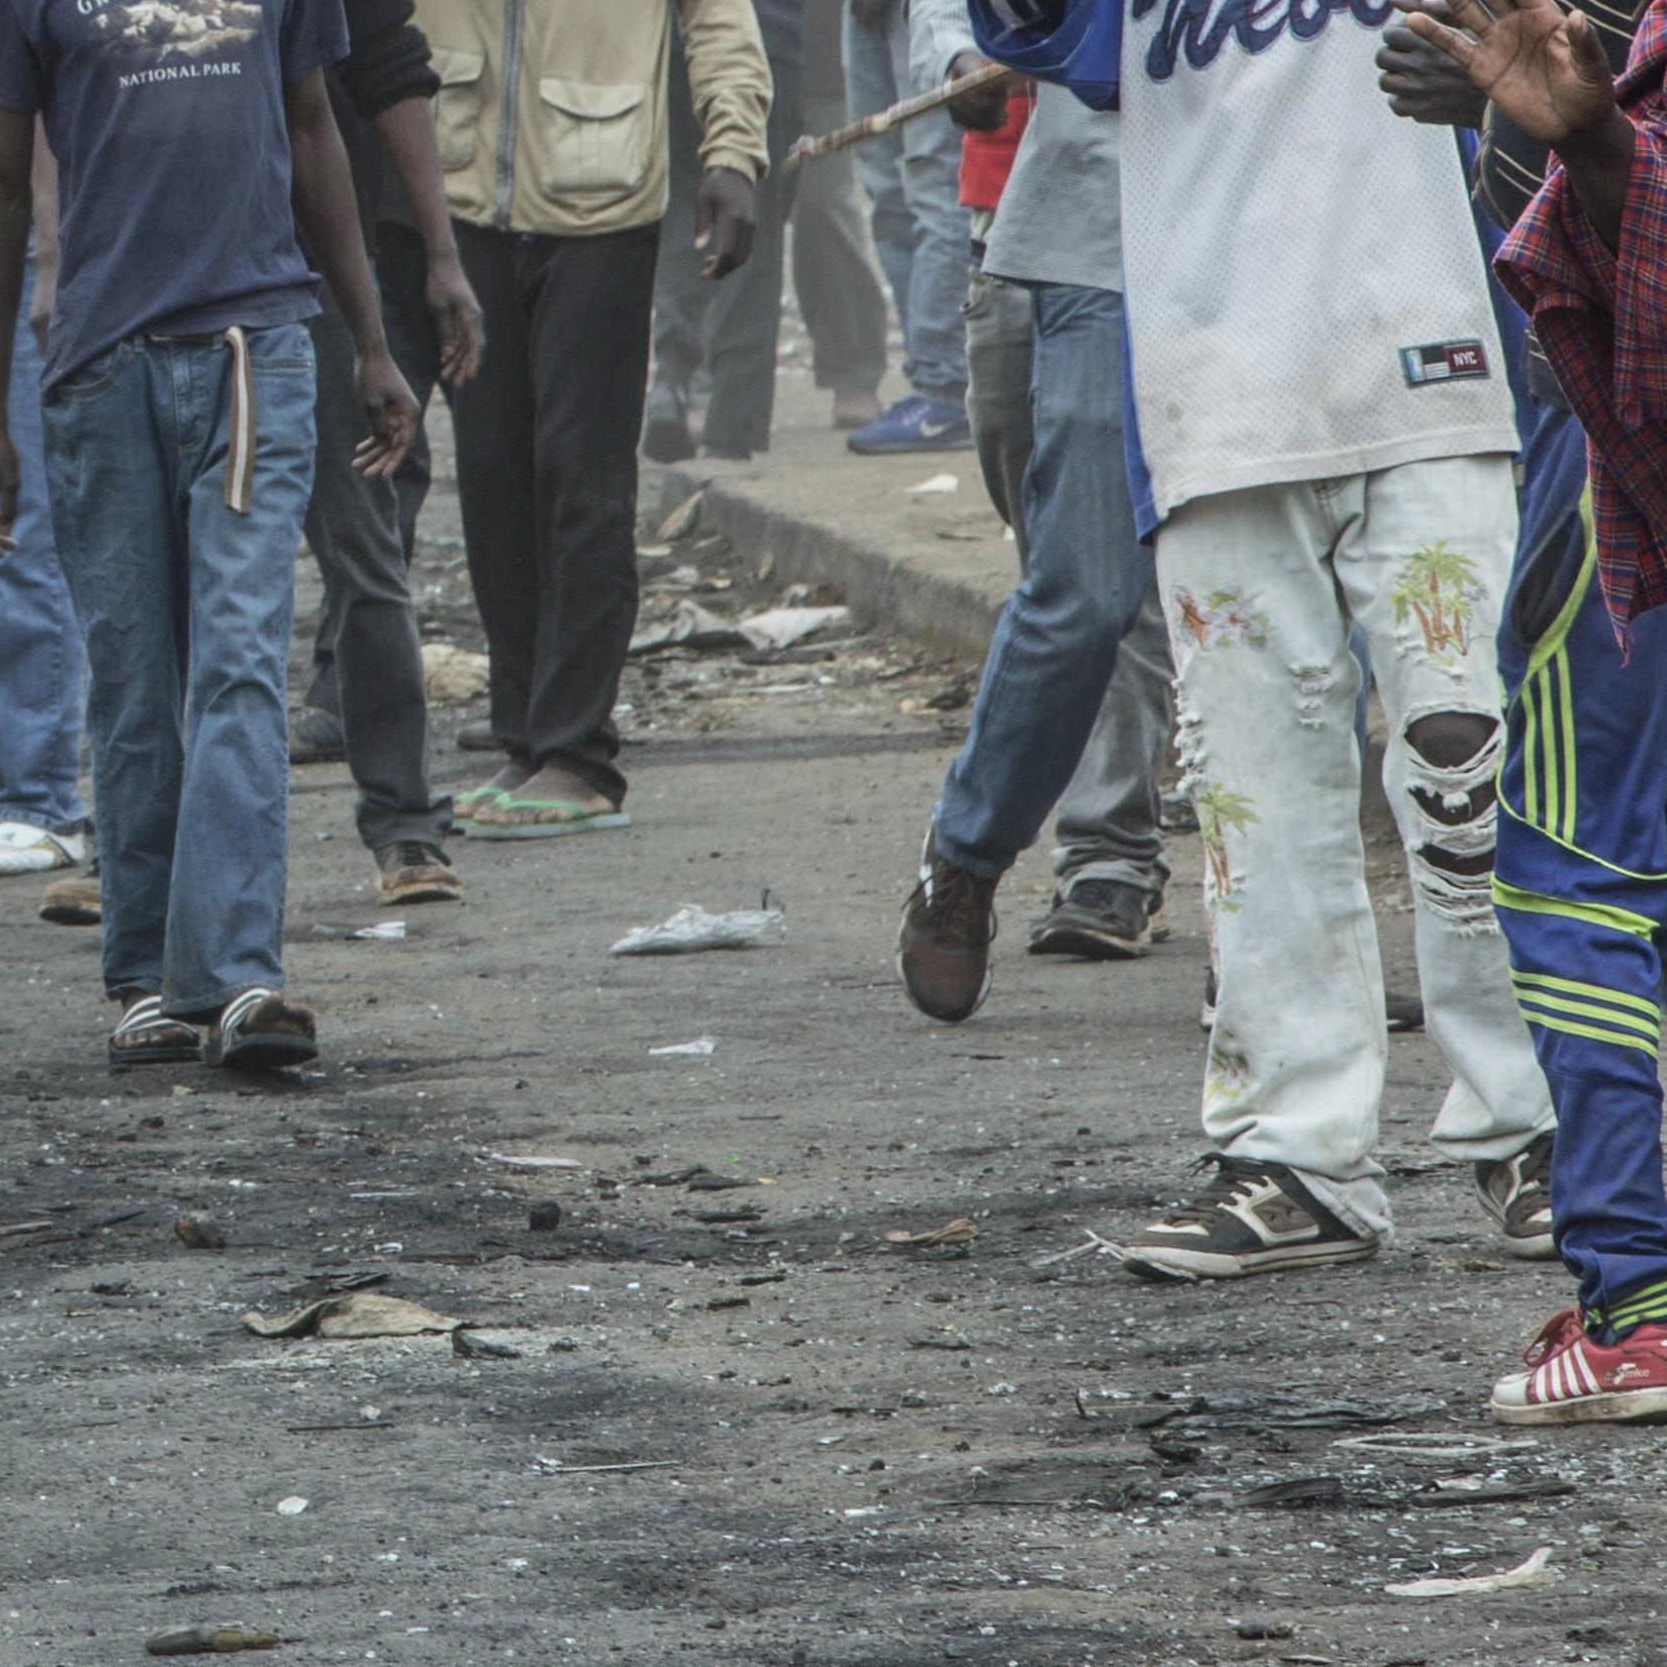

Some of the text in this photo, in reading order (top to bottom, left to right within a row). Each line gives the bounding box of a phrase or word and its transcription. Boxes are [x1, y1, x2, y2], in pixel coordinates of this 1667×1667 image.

[119, 61, 242, 89] NATIONAL PARK
[1452, 350, 1478, 367] NYC
